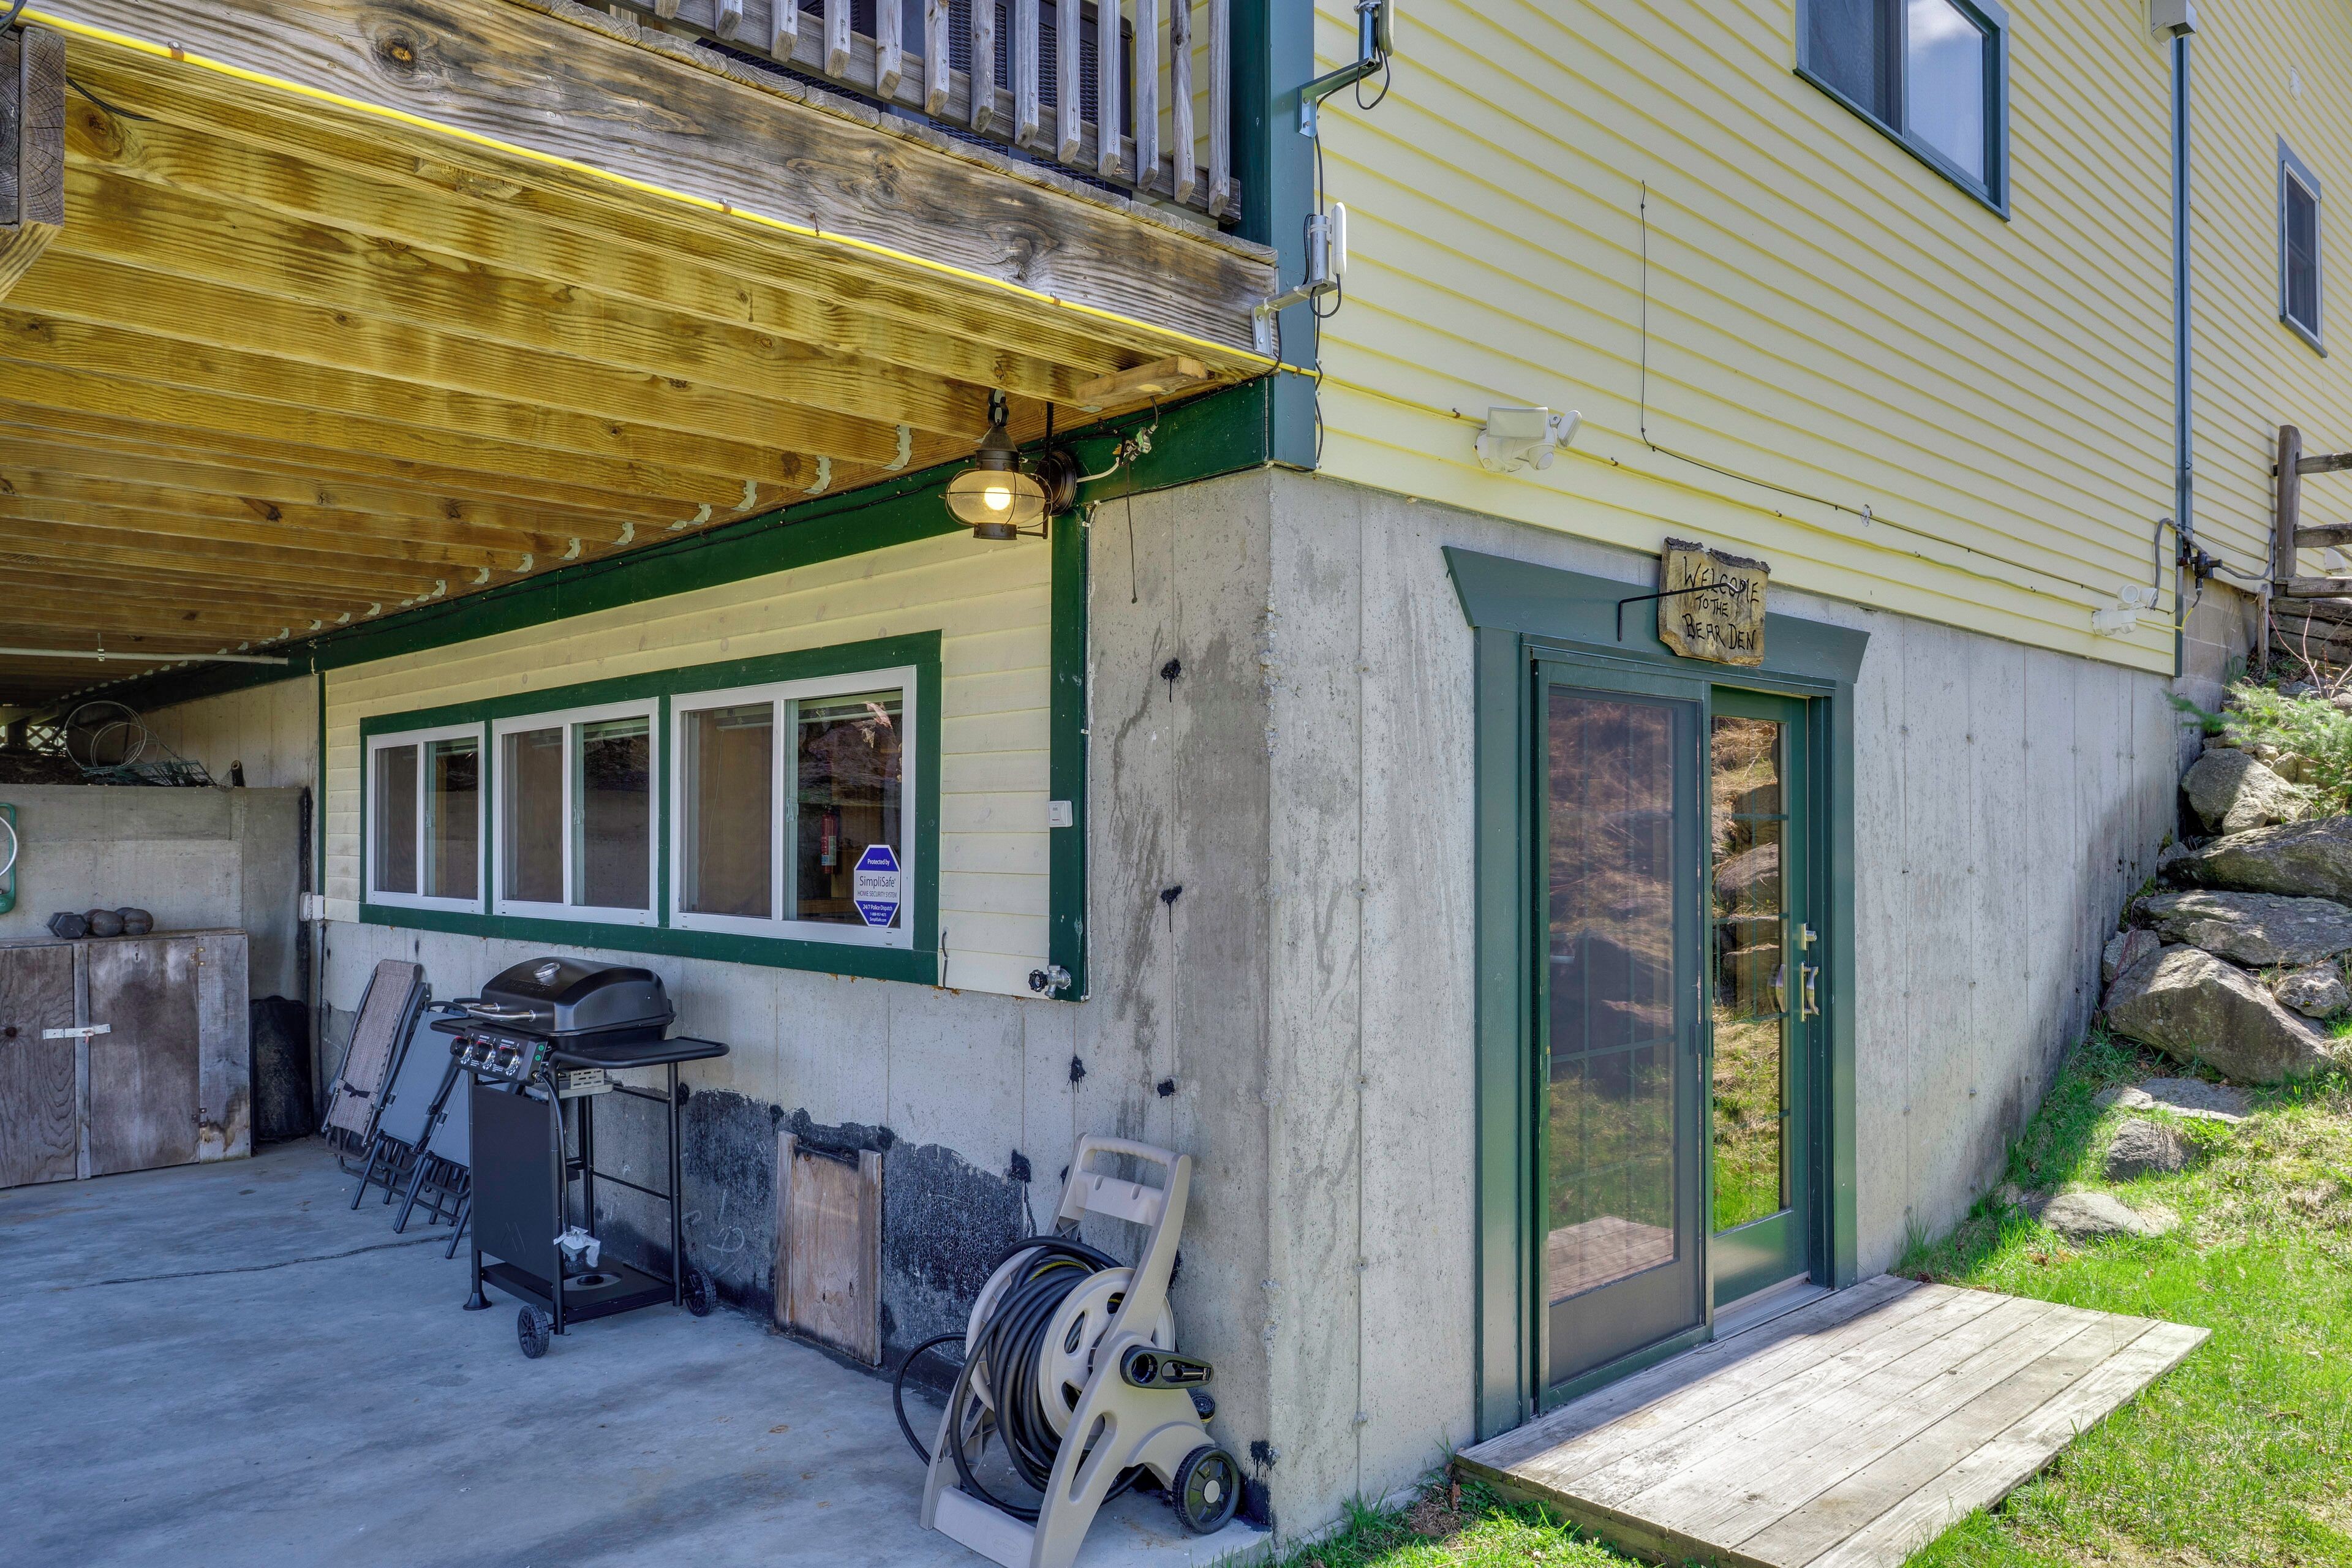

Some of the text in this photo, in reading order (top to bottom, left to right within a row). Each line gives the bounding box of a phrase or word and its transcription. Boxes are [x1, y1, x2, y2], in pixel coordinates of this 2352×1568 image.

[1683, 556, 1760, 603] WELCOME
[1695, 593, 1728, 617] TO THE
[1682, 613, 1756, 650] BEAR DEN
